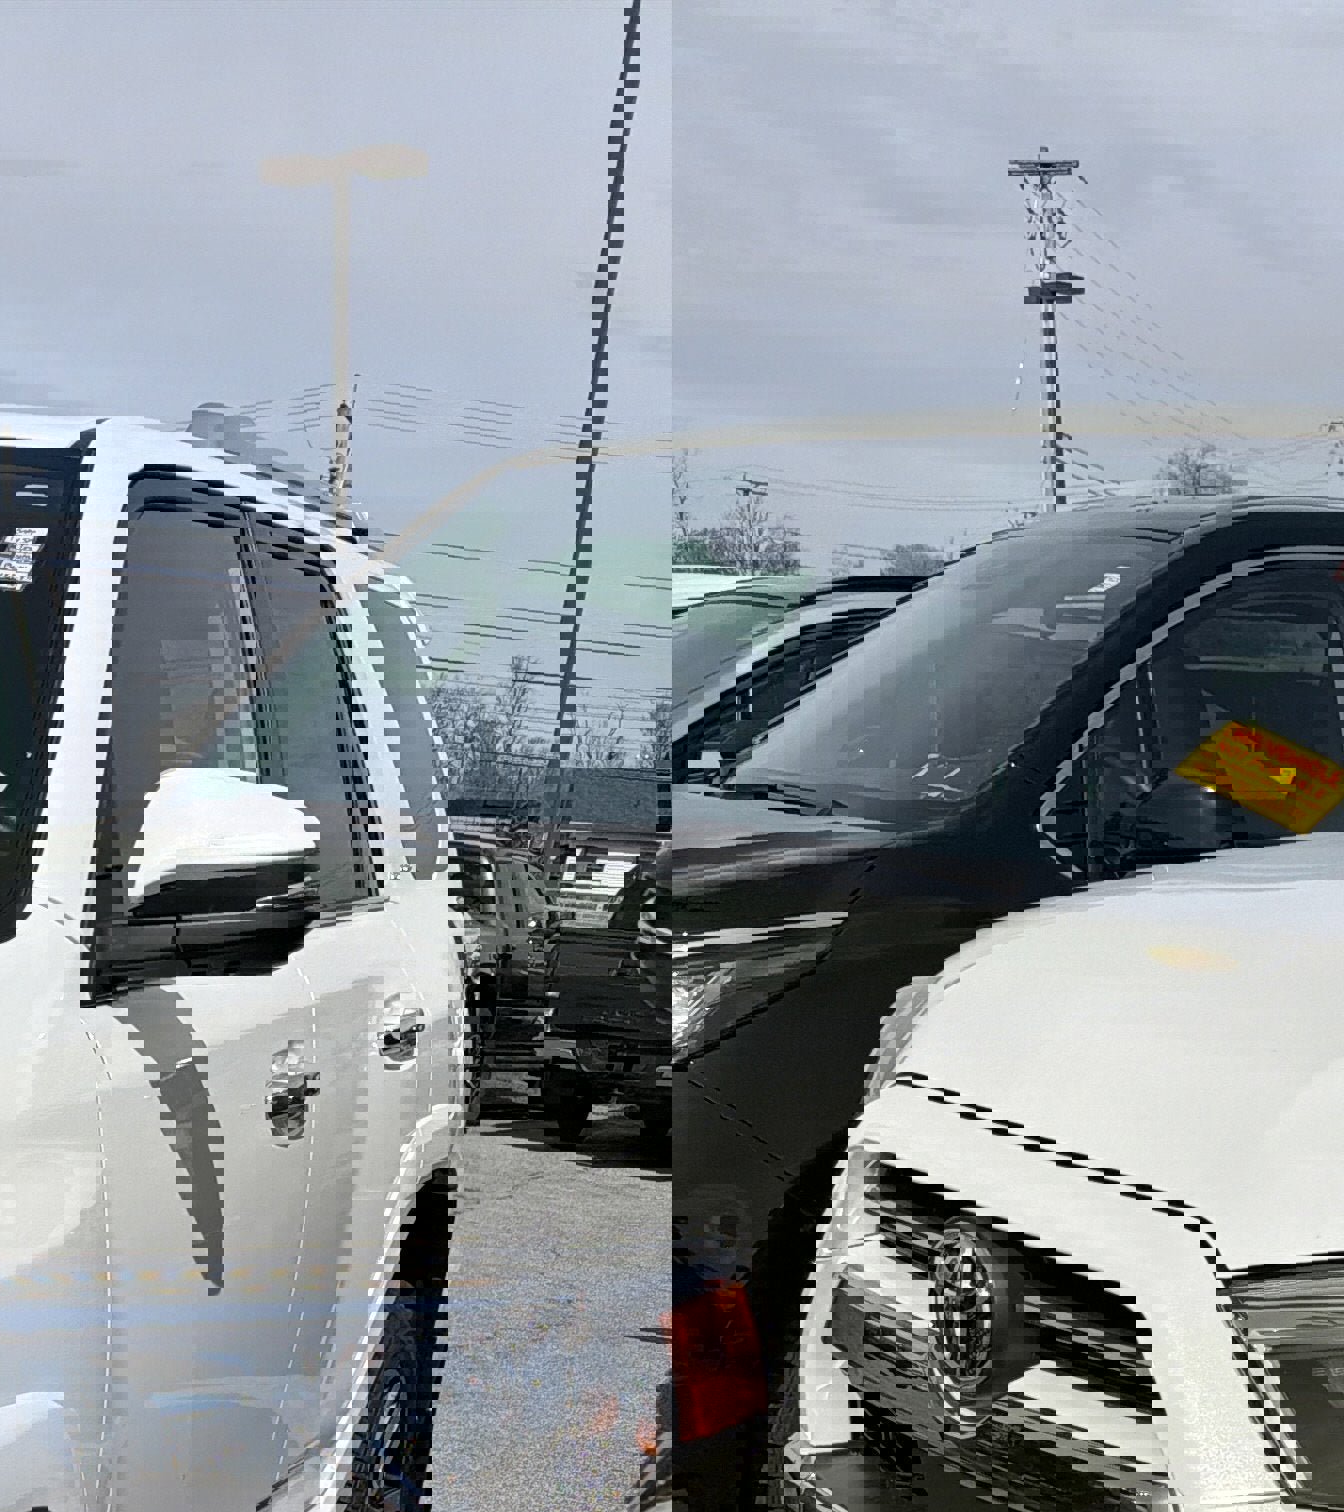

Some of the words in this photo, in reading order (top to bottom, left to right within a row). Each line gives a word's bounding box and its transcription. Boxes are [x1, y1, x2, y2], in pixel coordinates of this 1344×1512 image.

[1223, 723, 1262, 750] THIS
[1214, 740, 1251, 760] NOT
[1247, 756, 1284, 778] FOR
[1283, 774, 1330, 800] SALE
[1228, 762, 1258, 779] DEALER
[1256, 776, 1274, 787] FOR
